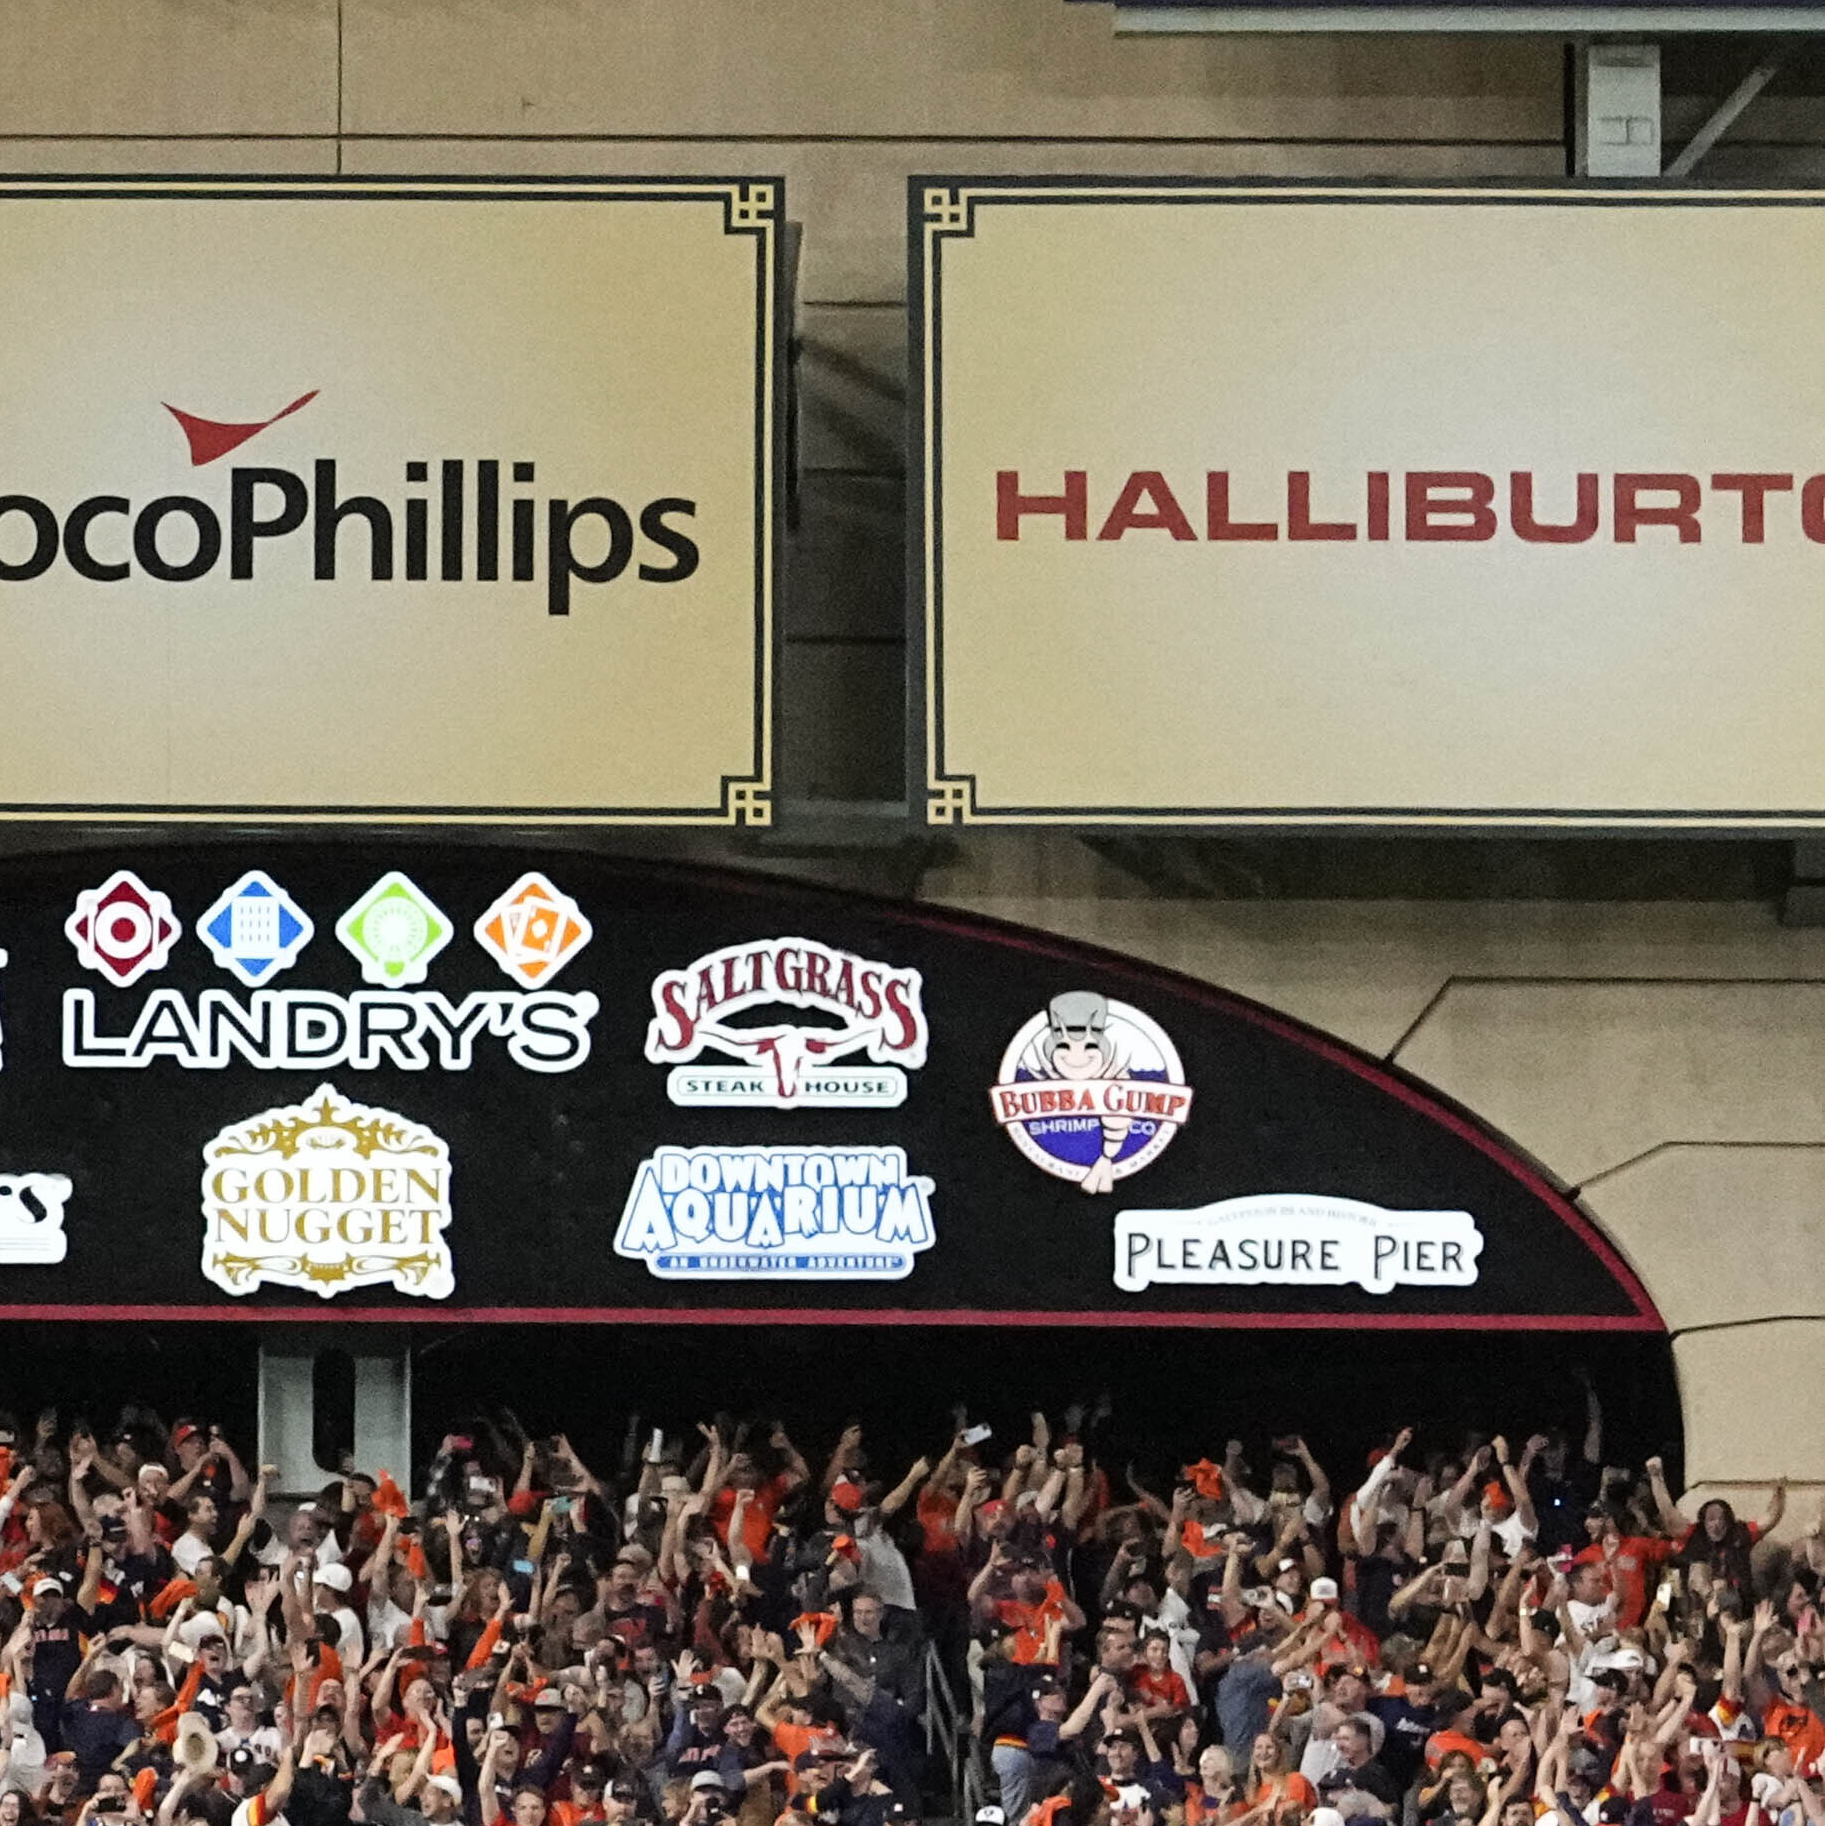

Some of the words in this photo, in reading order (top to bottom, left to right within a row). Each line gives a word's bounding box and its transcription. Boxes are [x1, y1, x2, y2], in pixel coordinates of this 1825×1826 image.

[996, 470, 1825, 543] HALLIBURT
[654, 947, 918, 1052] SALTGRASS
[72, 997, 580, 1064] LANDRY'S
[686, 1080, 766, 1094] STEAK
[804, 1080, 891, 1094] HOUSE
[999, 1087, 1096, 1119] BUBBA
[1102, 1083, 1187, 1117] GUMP
[1028, 1118, 1100, 1137] SHRIMP
[211, 1167, 443, 1205] GOLDEN
[660, 1153, 901, 1195] DOWNTOWN
[213, 1207, 443, 1245] NUGGET
[621, 1167, 929, 1253] AQUARIUM
[1126, 1232, 1342, 1278] PLEASURE
[1373, 1234, 1465, 1280] PIER
